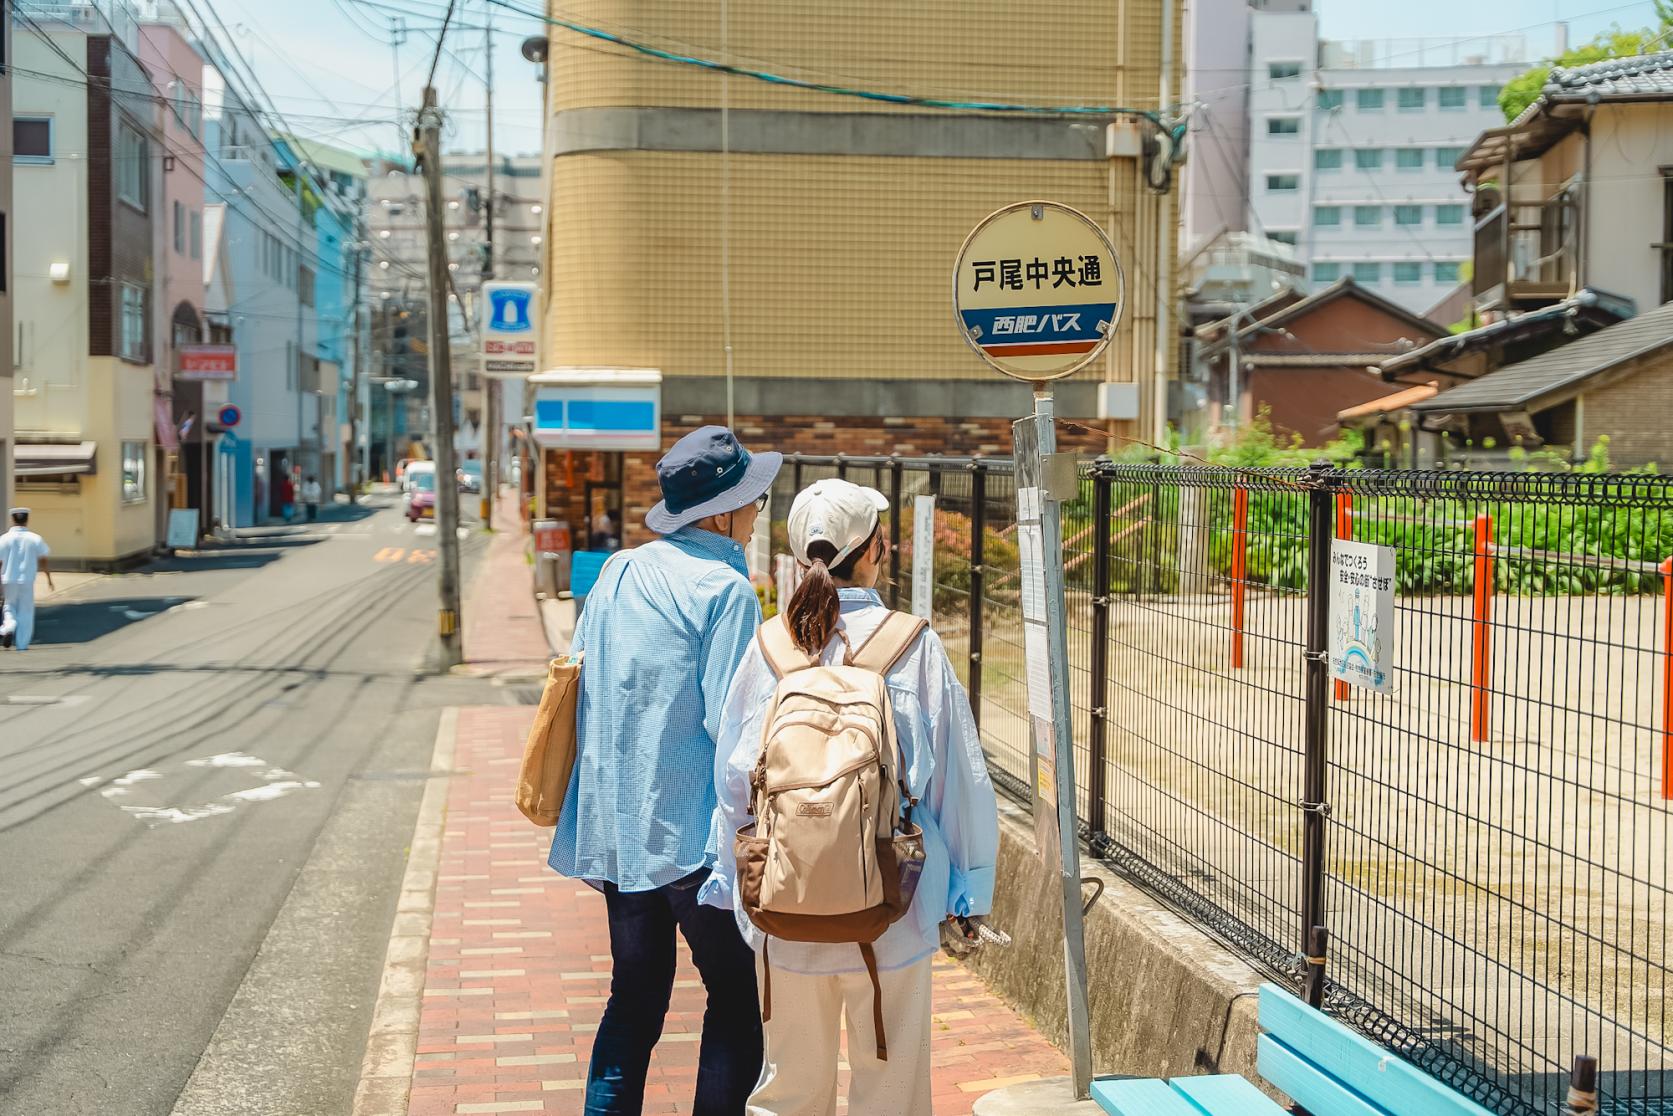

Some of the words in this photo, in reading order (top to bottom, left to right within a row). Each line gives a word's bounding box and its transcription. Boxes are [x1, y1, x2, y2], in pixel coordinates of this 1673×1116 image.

[972, 255, 1102, 292] 戸尾中央通
[991, 313, 1081, 335] 西肥バス
[1332, 551, 1367, 570] みんなでつくろう
